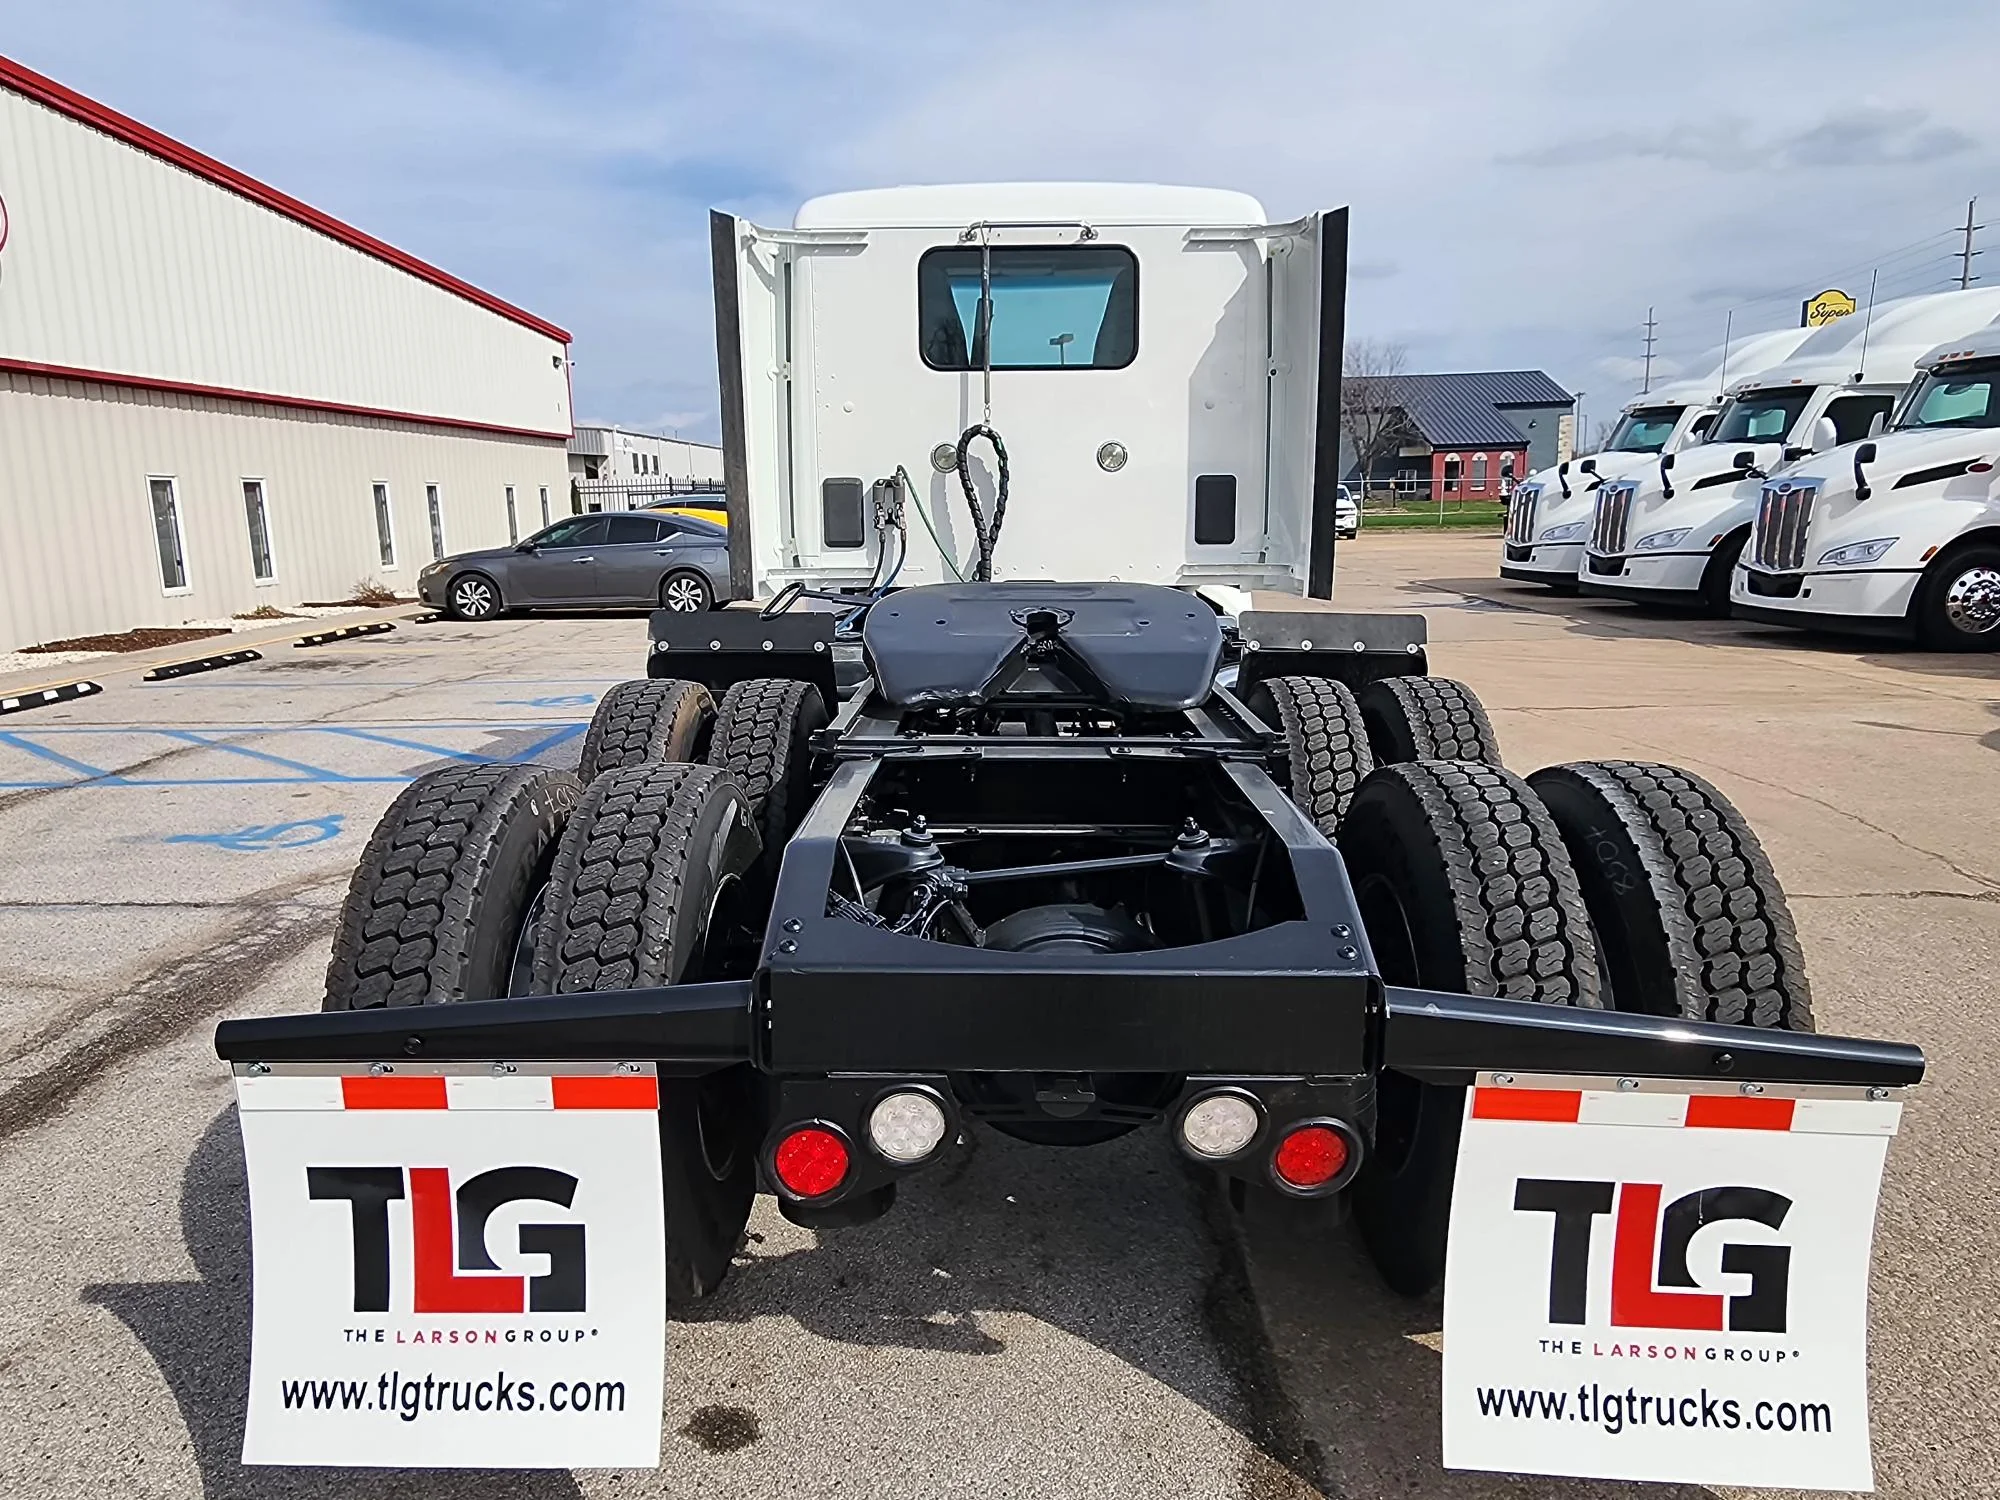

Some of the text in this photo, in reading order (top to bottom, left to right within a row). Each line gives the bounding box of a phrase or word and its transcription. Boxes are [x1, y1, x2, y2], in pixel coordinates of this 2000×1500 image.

[1810, 302, 1853, 326] Super
[306, 1166, 586, 1313] TLG
[1514, 1178, 1793, 1333] TLG
[344, 1329, 385, 1343] THE
[396, 1330, 497, 1344] LARSON
[1539, 1339, 1582, 1355] THE
[1593, 1343, 1696, 1360] LARSON
[282, 1371, 625, 1422] www.tlgtrucks.com
[1477, 1384, 1832, 1434] www.tlgtrucks.com
